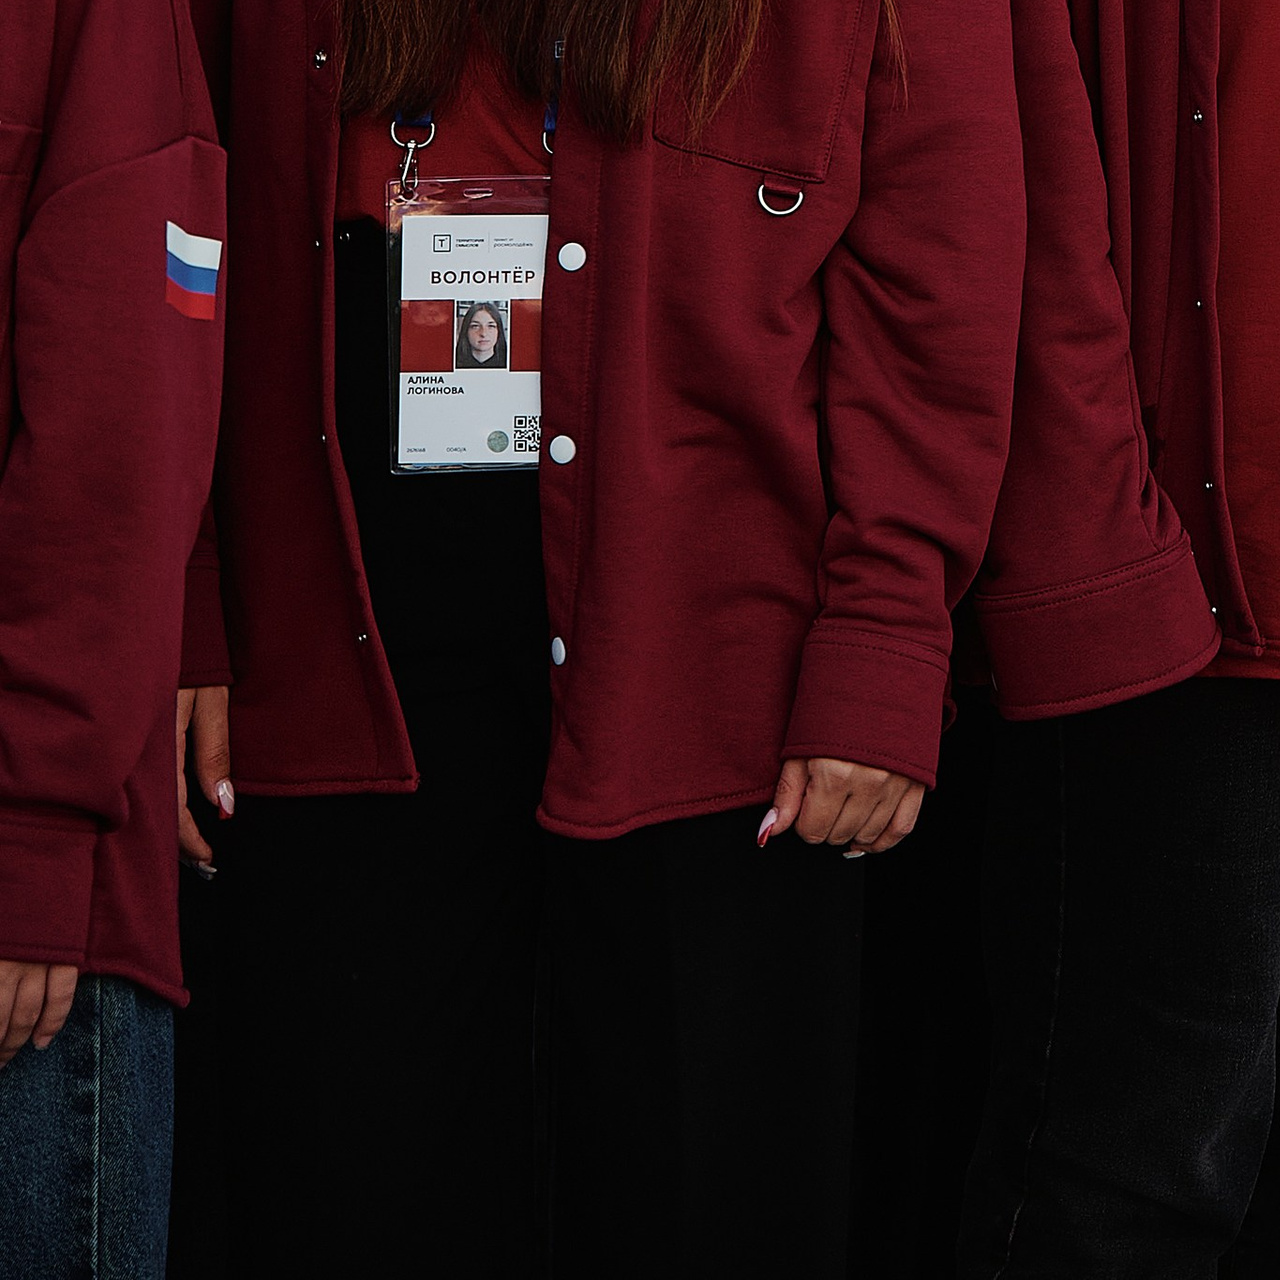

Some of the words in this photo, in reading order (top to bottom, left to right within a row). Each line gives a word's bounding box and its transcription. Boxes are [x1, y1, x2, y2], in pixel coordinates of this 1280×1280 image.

[431, 266, 536, 284] ВОЛОНТЁР
[407, 376, 445, 385] АЛИНА
[406, 387, 465, 395] ЛОГИНОВА
